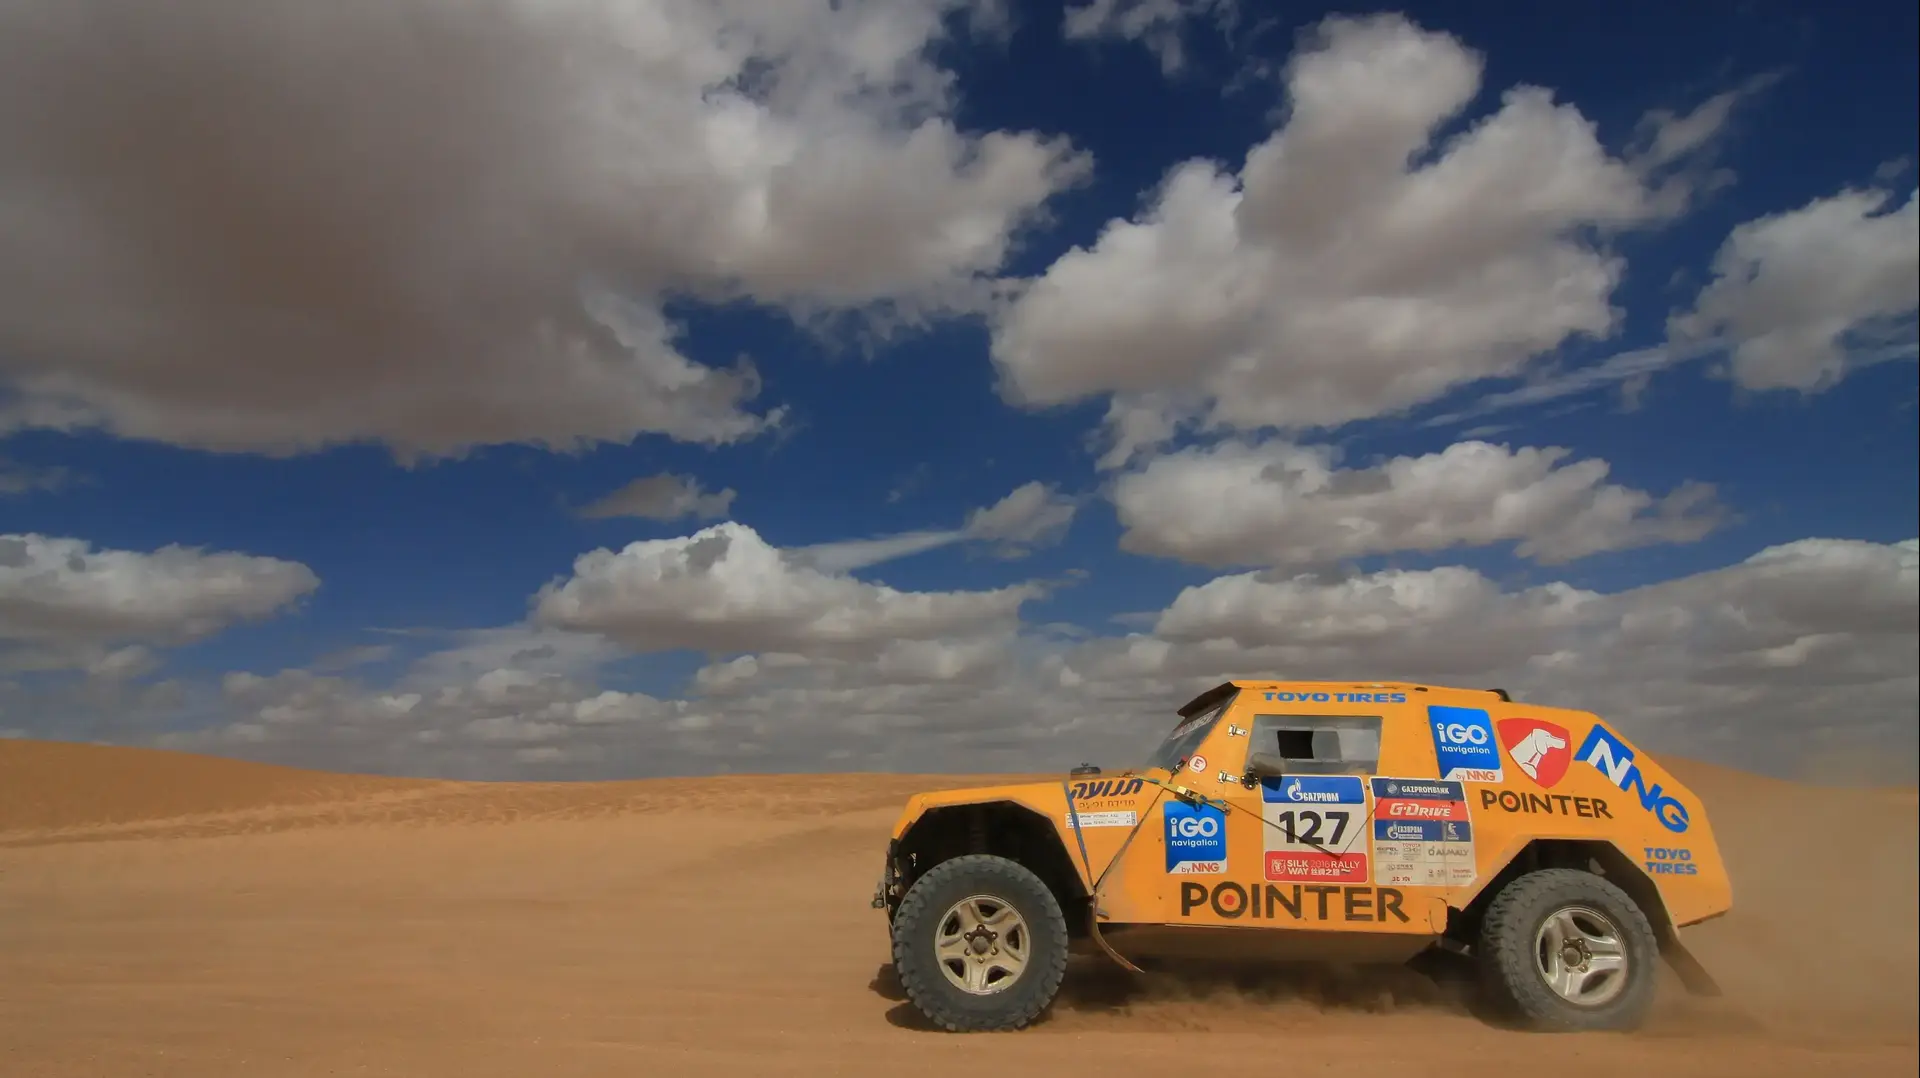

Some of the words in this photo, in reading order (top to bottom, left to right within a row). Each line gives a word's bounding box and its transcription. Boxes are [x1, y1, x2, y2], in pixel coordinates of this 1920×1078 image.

[1263, 692, 1330, 702] TOYO
[1333, 692, 1406, 703] TIRES
[1436, 723, 1488, 745] iGO
[1441, 745, 1490, 755] navigation
[1193, 758, 1204, 768] E
[1456, 773, 1466, 782] by
[1466, 770, 1496, 781] NNG
[1401, 785, 1450, 795] GAZPROMBANK
[1586, 737, 1690, 833] NNG
[1303, 792, 1339, 802] GAZPROM
[1480, 789, 1614, 819] POINTER
[1170, 817, 1218, 838] iGO
[1279, 810, 1350, 845] 127
[1171, 838, 1218, 848] navigation
[1644, 848, 1691, 861] TOYO
[1191, 863, 1219, 873] NNG
[1287, 860, 1309, 868] SILK
[1310, 860, 1331, 868] 2016
[1331, 860, 1360, 869] RALLY
[1646, 862, 1697, 875] TIRES
[1181, 881, 1410, 923] POINTER
